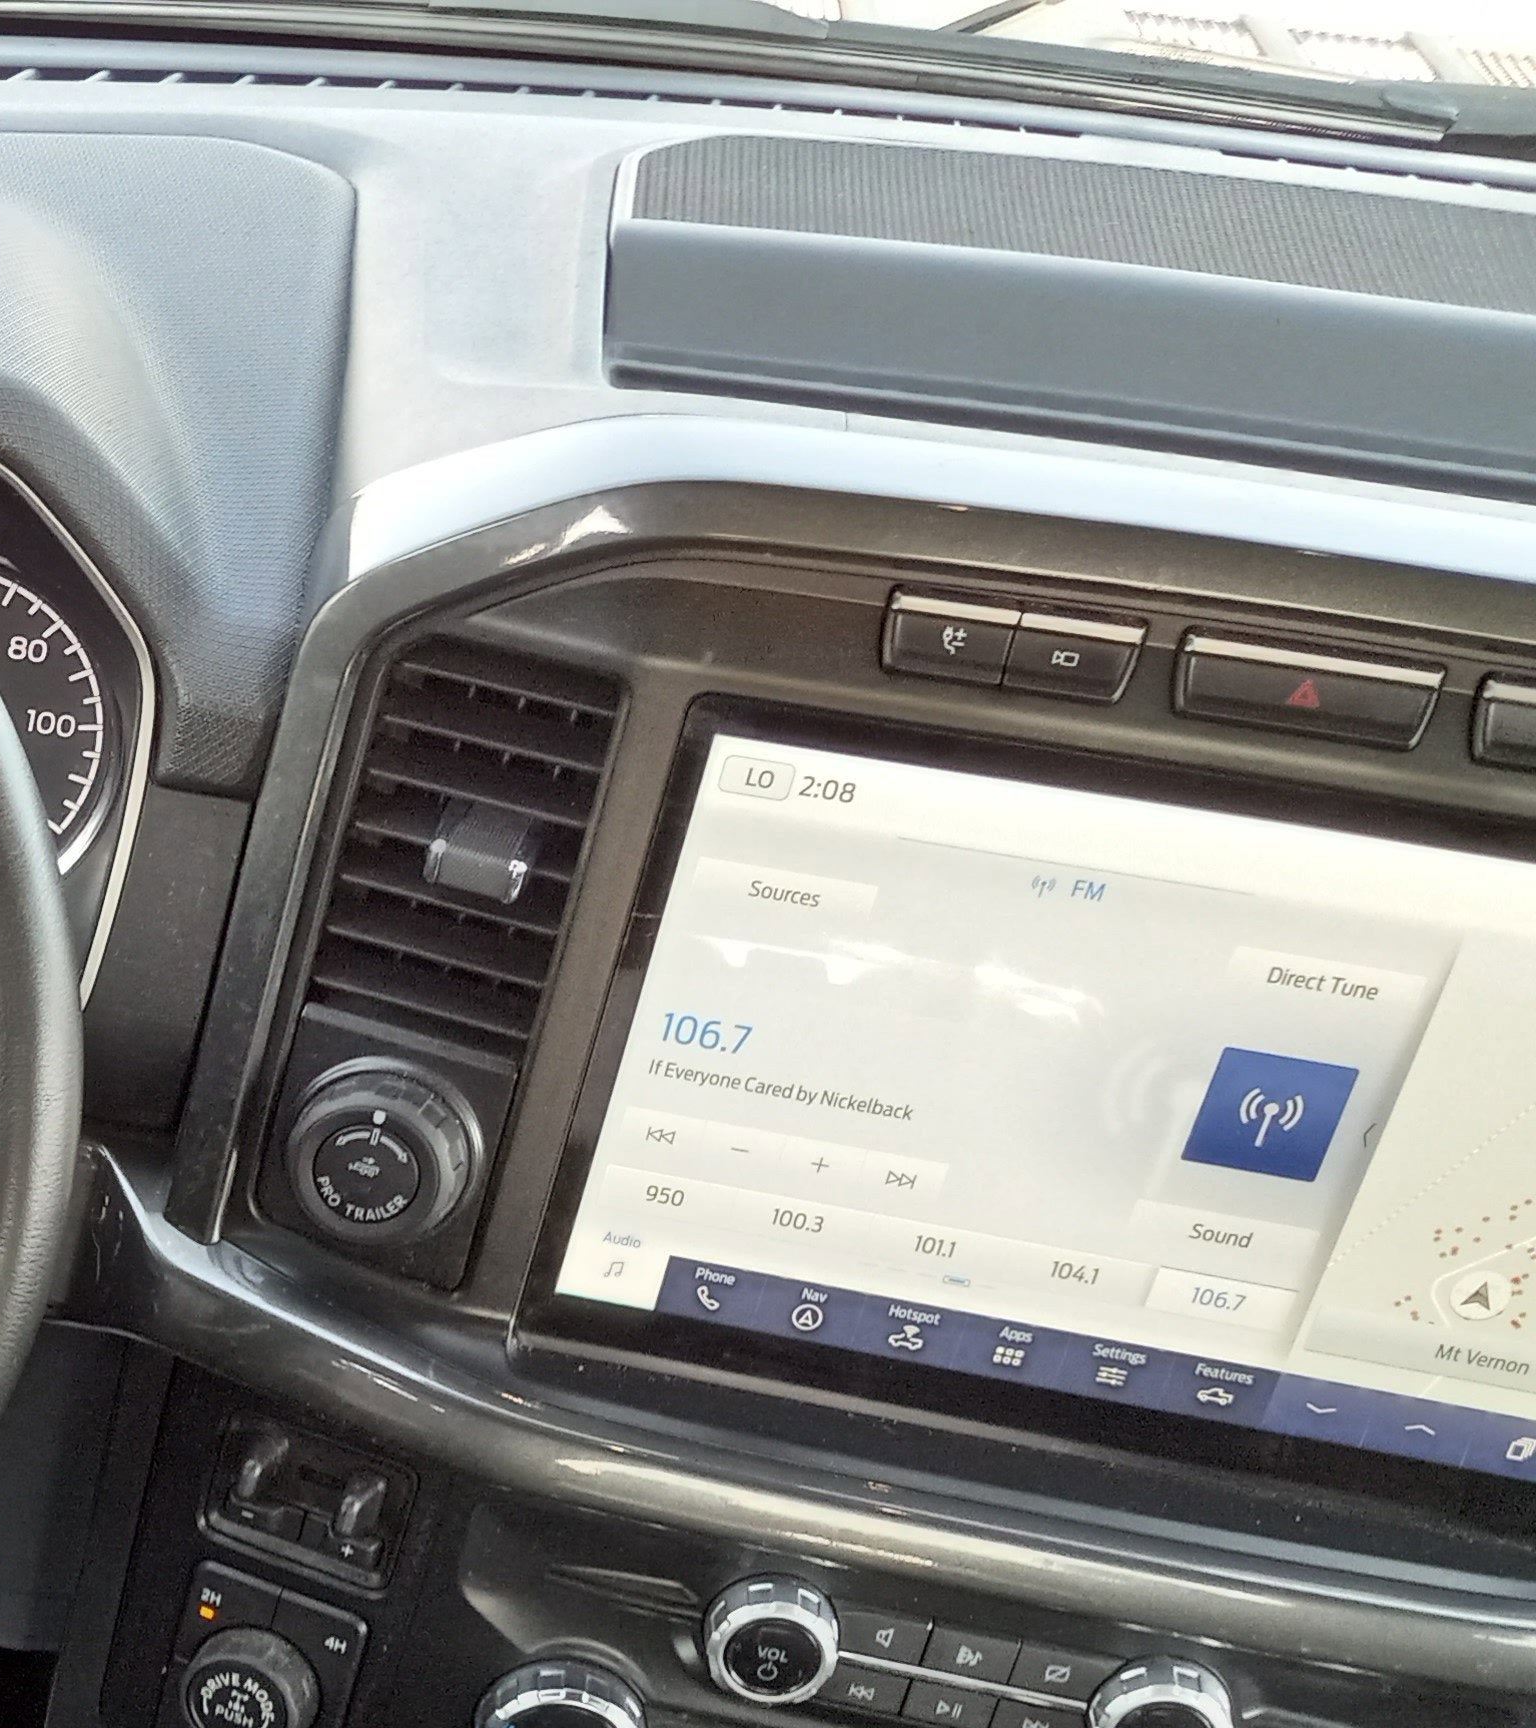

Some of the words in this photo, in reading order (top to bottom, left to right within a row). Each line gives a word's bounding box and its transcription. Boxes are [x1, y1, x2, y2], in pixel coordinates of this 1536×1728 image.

[7, 635, 48, 664] 80
[27, 708, 76, 738] 100
[745, 767, 775, 789] LO
[799, 776, 857, 804] 2:08
[748, 880, 821, 908] Sources
[1071, 879, 1107, 902] FM
[1267, 966, 1326, 993] Direct
[1330, 976, 1379, 1001] Tune
[662, 1012, 753, 1054] 106.7
[648, 1059, 663, 1076] If
[664, 1062, 741, 1090] Everyone
[744, 1076, 795, 1099] Cared
[796, 1085, 817, 1106] by
[819, 1090, 914, 1121] Nickelback
[317, 1175, 341, 1207] PRO
[345, 1194, 408, 1221] TRAILER
[645, 1185, 685, 1207] 950
[771, 1208, 825, 1234] 100.3
[602, 1231, 642, 1249] Audio
[914, 1235, 957, 1258] 101.1
[1188, 1223, 1253, 1249] Sound
[694, 1267, 736, 1286] Phone
[1049, 1261, 1100, 1286] 104.1
[801, 1287, 828, 1304] Nav
[1190, 1286, 1247, 1312] 106.7
[888, 1304, 942, 1327] Hotspot
[999, 1326, 1033, 1344] Apps
[1092, 1343, 1147, 1366] Settings
[1434, 1344, 1462, 1362] Mt
[1467, 1350, 1530, 1376] Vernon
[1194, 1363, 1255, 1385] Features
[324, 1636, 347, 1655] 4H
[757, 1644, 788, 1664] VOL
[200, 1672, 240, 1699] DRIVE
[243, 1677, 275, 1722] MODE
[215, 1704, 254, 1728] PUSH
